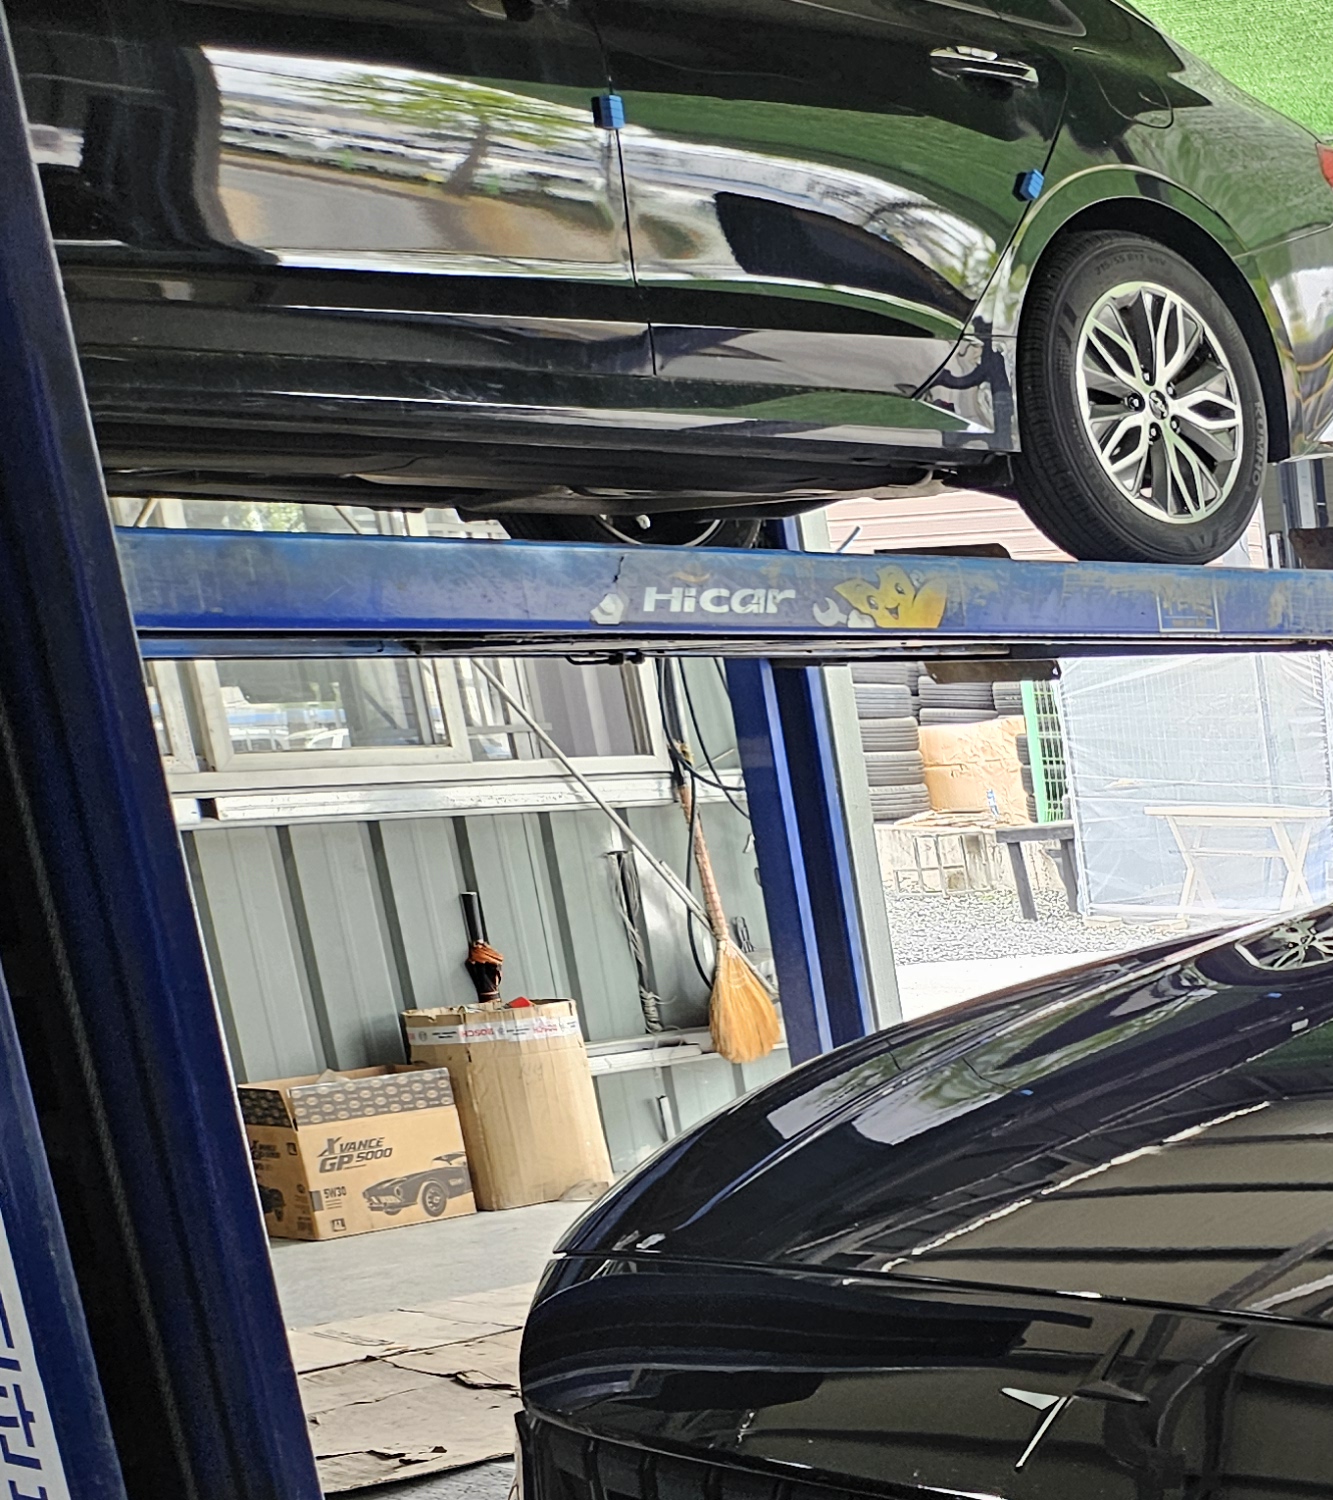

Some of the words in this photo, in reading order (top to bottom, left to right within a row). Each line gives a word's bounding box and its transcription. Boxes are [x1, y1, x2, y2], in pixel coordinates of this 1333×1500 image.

[1252, 401, 1265, 486] KUMHO
[643, 587, 796, 614] Hicar
[319, 1153, 354, 1174] GP
[355, 1147, 393, 1163] 5000
[323, 1186, 347, 1199] 5W30
